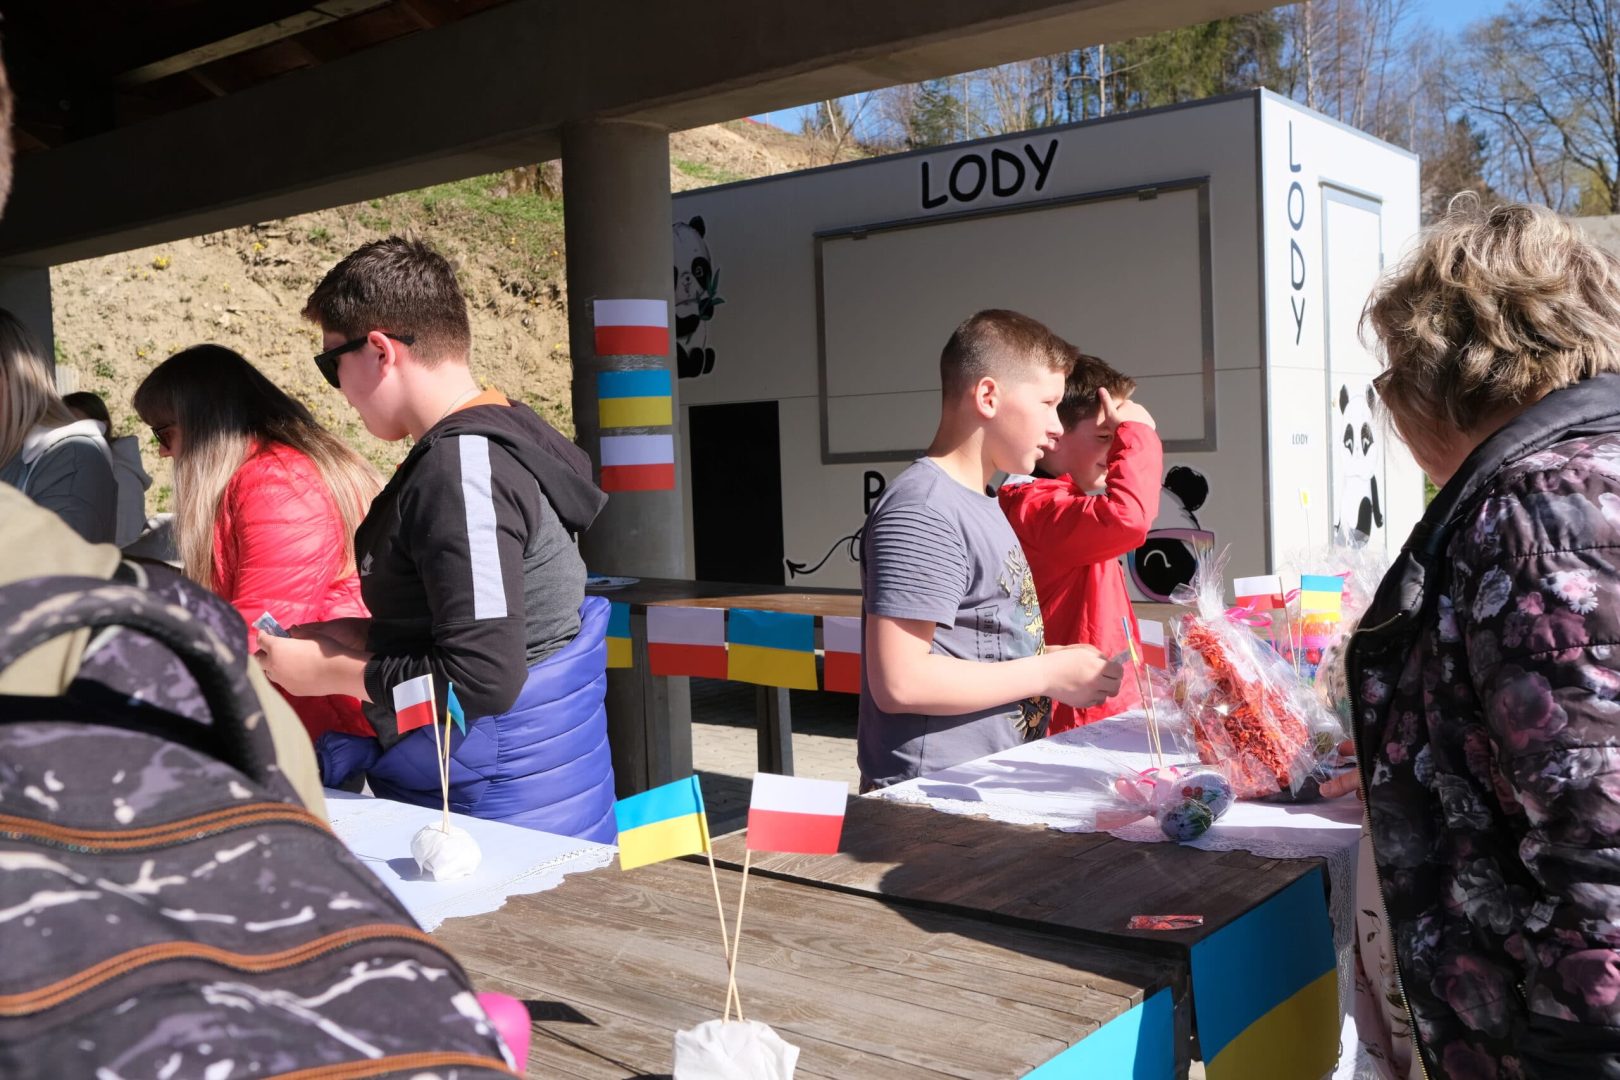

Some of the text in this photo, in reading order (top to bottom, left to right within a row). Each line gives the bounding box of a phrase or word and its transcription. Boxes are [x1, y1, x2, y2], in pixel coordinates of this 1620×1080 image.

[922, 139, 1059, 209] LODY
[1287, 119, 1306, 346] LODY
[1291, 433, 1309, 446] LODY
